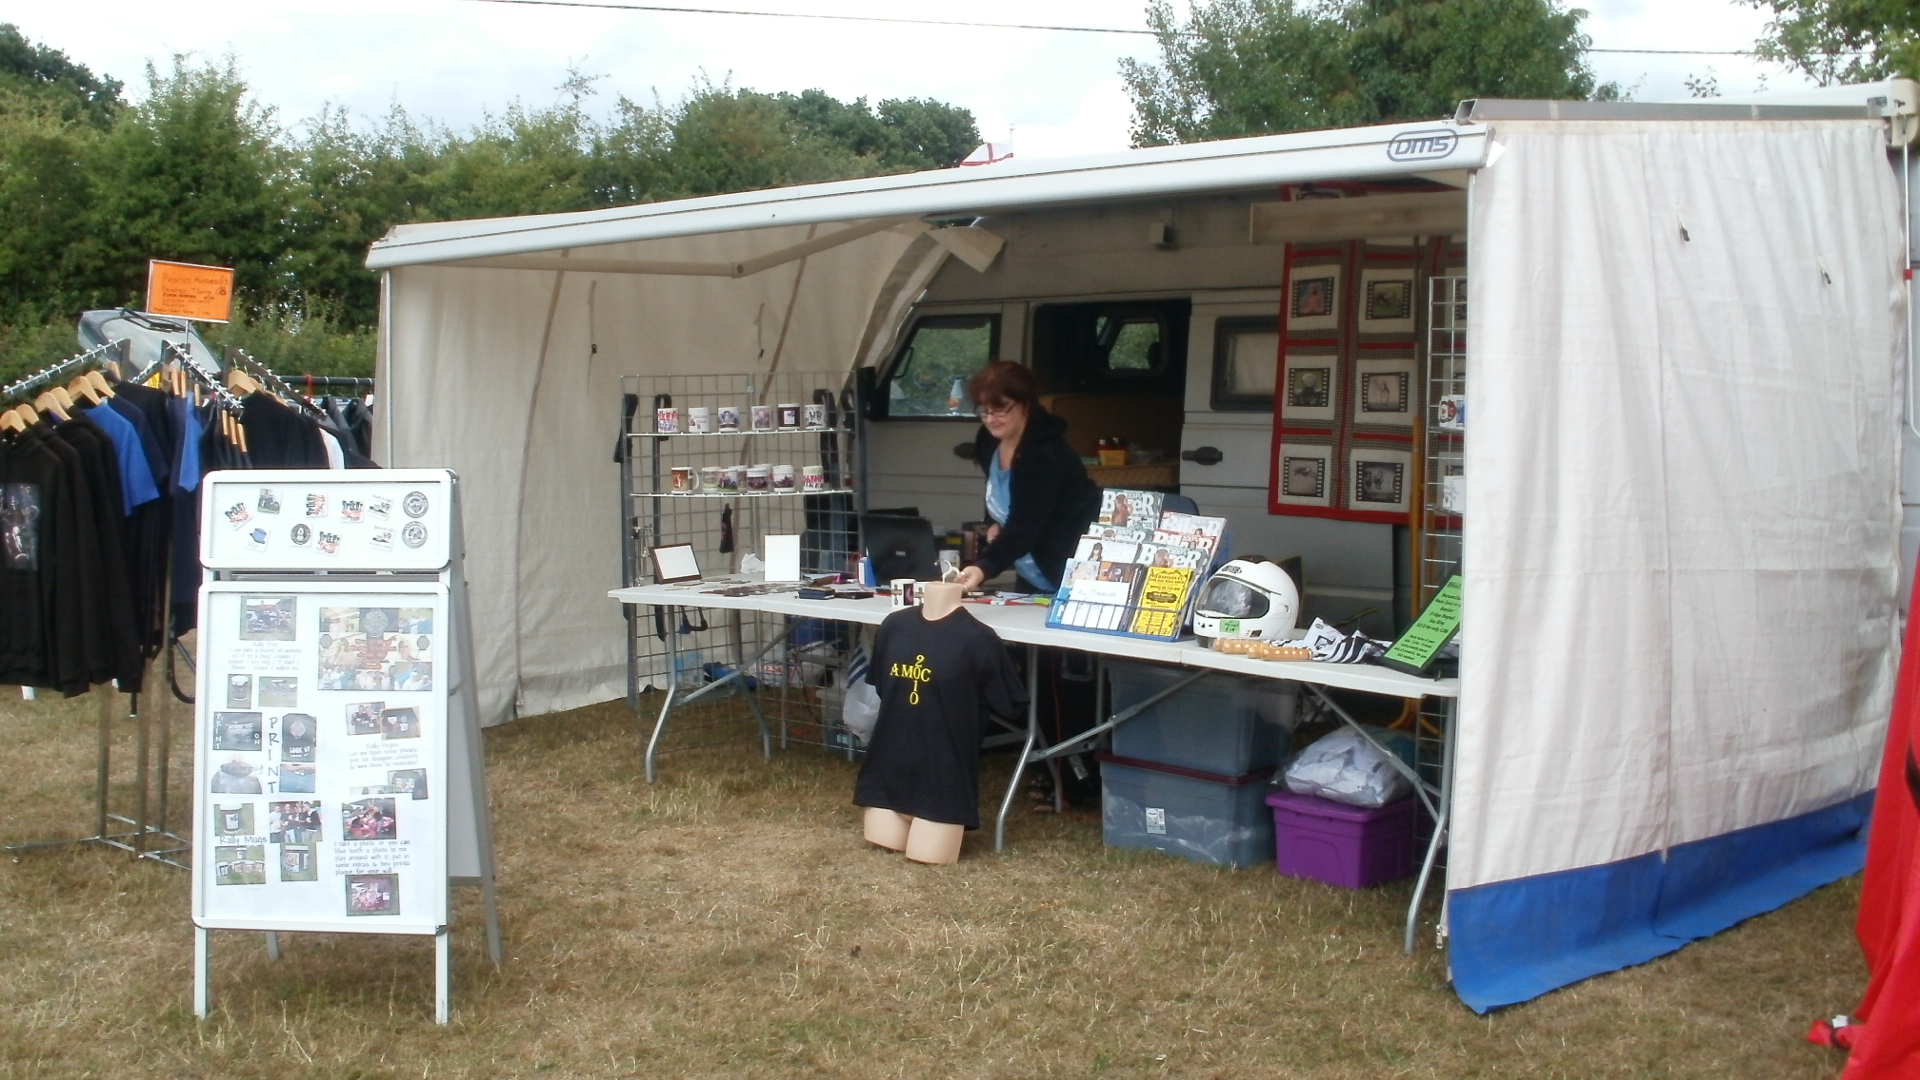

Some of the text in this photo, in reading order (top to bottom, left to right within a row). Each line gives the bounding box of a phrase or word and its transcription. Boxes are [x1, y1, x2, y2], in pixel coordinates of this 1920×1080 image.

[1394, 136, 1449, 155] DMS
[267, 716, 280, 794] PRINT
[218, 835, 267, 846] Rally Mugs
